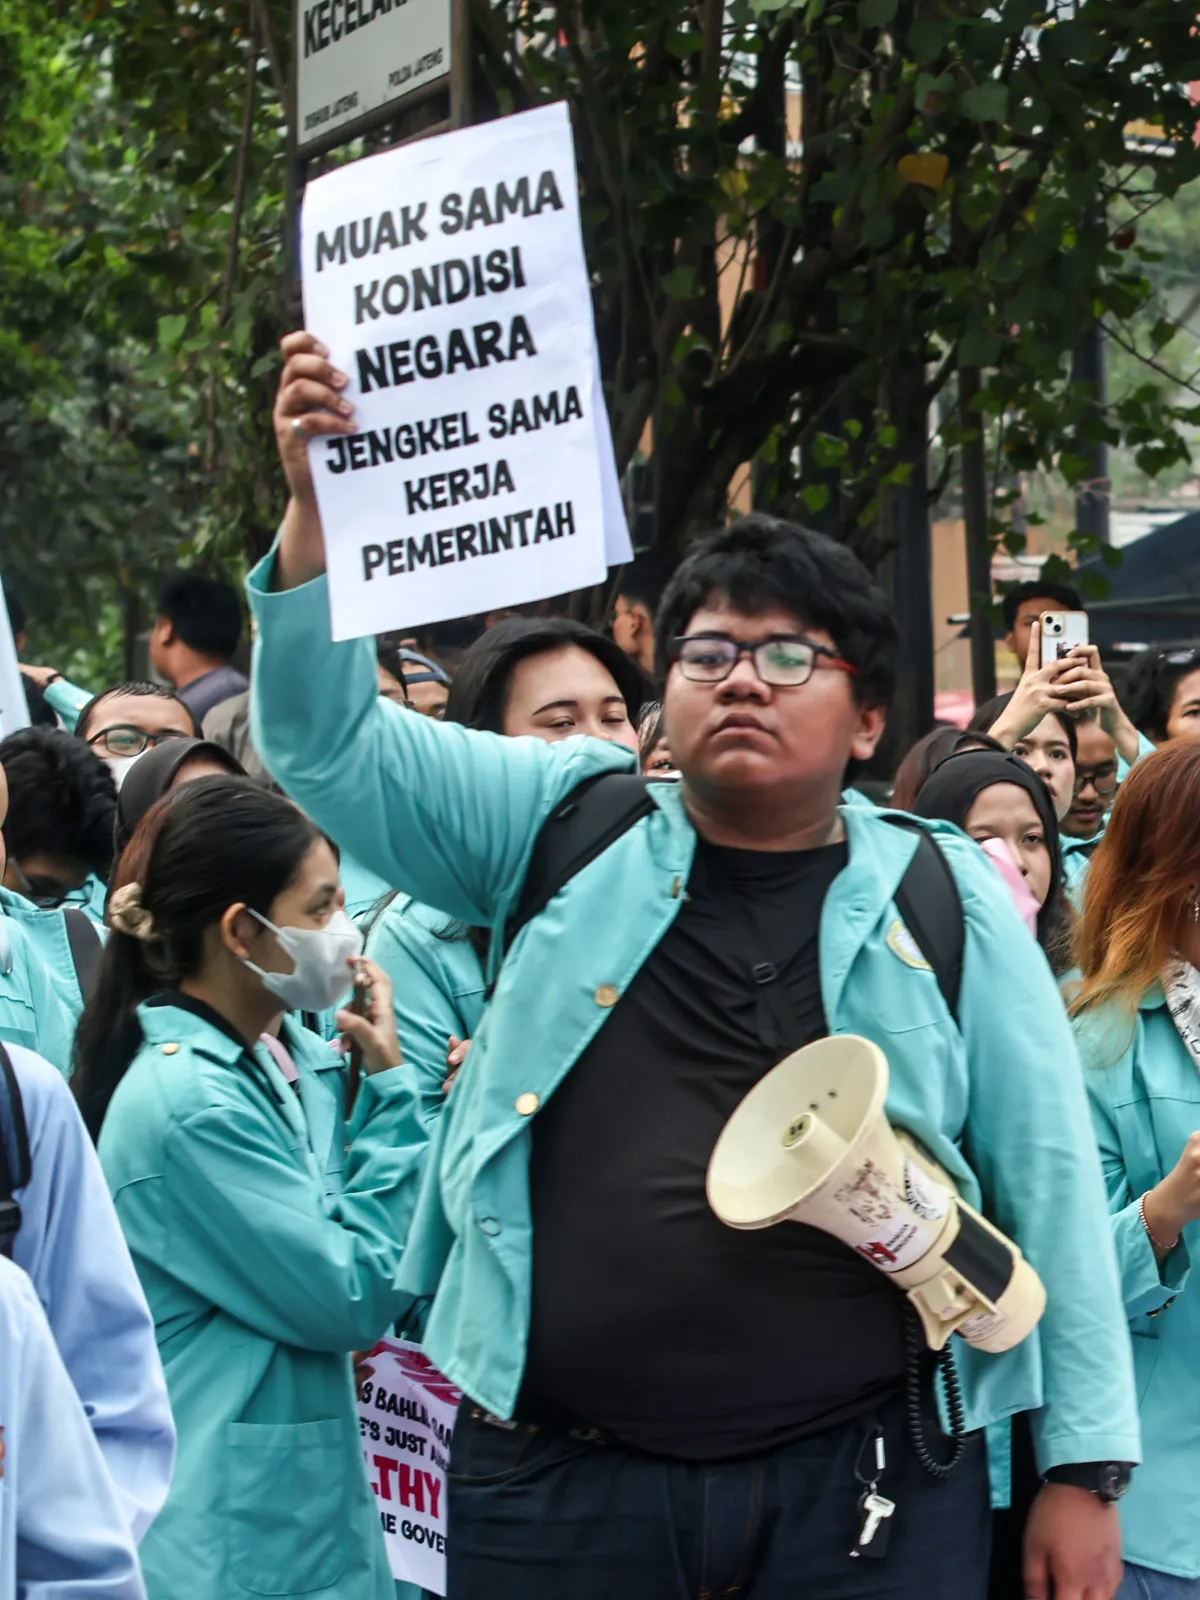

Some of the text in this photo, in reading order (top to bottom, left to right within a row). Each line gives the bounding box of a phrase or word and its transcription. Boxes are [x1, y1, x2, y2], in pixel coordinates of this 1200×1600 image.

[304, 0, 408, 59] KECEL
[315, 170, 564, 272] MUAK SAMA
[354, 246, 526, 325] KONDISI
[355, 315, 537, 394] NEGARA
[326, 385, 584, 474] JENGKEL SAMA
[403, 459, 516, 515] KERJA
[361, 500, 576, 581] PEMERINTAH
[385, 1426, 427, 1456] JUST
[370, 1454, 442, 1519] THY
[402, 1520, 447, 1556] GOVE
